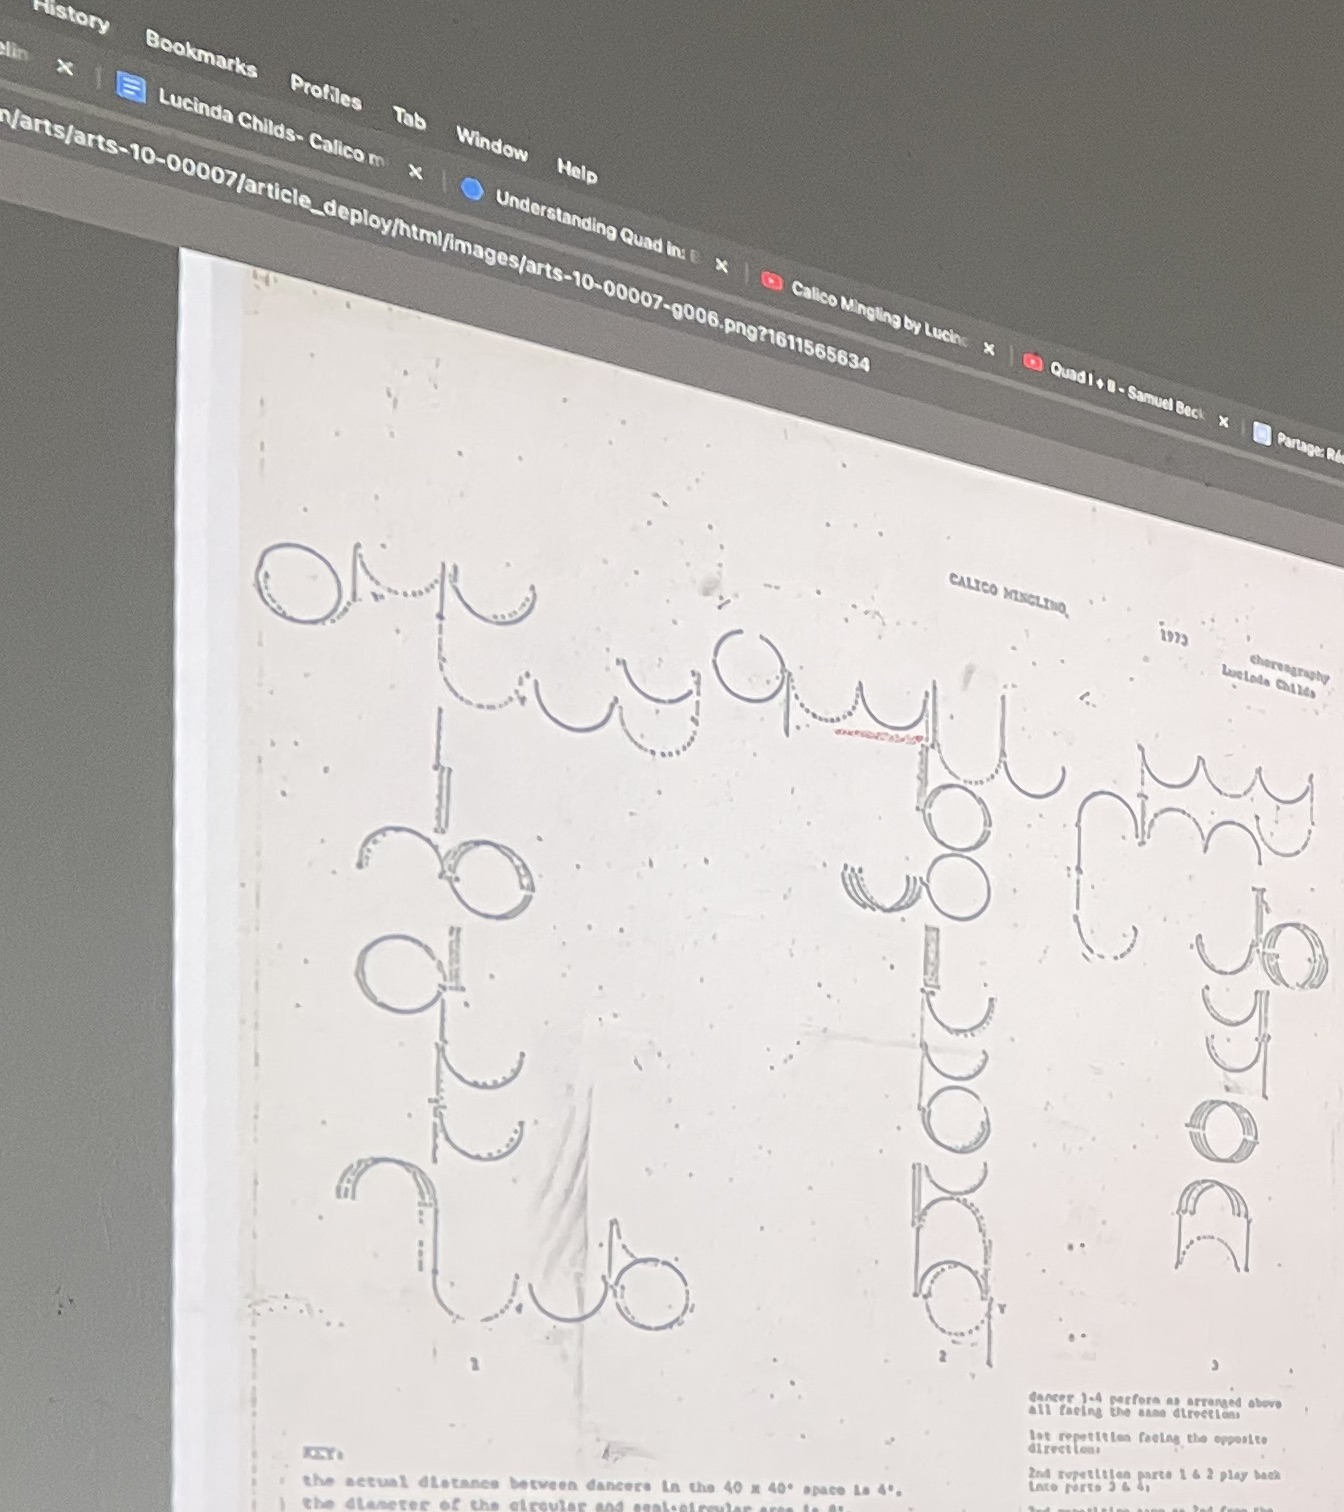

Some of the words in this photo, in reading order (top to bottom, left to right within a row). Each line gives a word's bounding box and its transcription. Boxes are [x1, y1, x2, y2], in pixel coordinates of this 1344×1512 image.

[33, 0, 110, 35] History
[145, 28, 258, 78] Bookmarks
[290, 73, 362, 111] Profiles
[393, 105, 427, 131] Tab
[456, 125, 528, 163] Window
[557, 157, 598, 185] Help
[159, 87, 234, 124] Lucinda
[309, 132, 365, 163] Calico
[496, 189, 617, 242] Understanding
[620, 226, 664, 255] Quad
[791, 280, 838, 308] Calico
[841, 295, 902, 330] Mingling
[904, 314, 921, 336] by
[1050, 361, 1086, 385] Quad
[1128, 386, 1173, 412] Samuel
[949, 573, 998, 597] CALICO
[1160, 628, 1189, 646] 1973
[1221, 663, 1270, 687] Lucinda
[1275, 678, 1316, 699] Childs
[1250, 654, 1330, 685] choreography
[1028, 1391, 1075, 1404] dancer
[1109, 1393, 1161, 1407] perform
[1165, 1396, 1180, 1407] as
[1187, 1396, 1243, 1410] arranged
[1248, 1397, 1283, 1410] above
[1028, 1403, 1052, 1416] all
[1059, 1403, 1103, 1419] facing
[1109, 1406, 1131, 1418] the
[1138, 1408, 1167, 1418] same
[1029, 1429, 1051, 1441] 1st
[1058, 1431, 1131, 1444] repetition
[1138, 1431, 1180, 1445] facing
[1187, 1433, 1208, 1444] the
[1214, 1434, 1268, 1447] opposite
[303, 1473, 335, 1487] the
[345, 1474, 409, 1489] actual
[418, 1475, 500, 1490] distance
[509, 1476, 578, 1490] between
[586, 1478, 652, 1493] dancers
[662, 1479, 681, 1493] in
[690, 1480, 716, 1494] the
[724, 1480, 743, 1494] 40
[802, 1482, 846, 1497] space
[853, 1484, 871, 1497] is
[1028, 1467, 1051, 1480] 2nd
[1058, 1468, 1132, 1482] repetition
[1137, 1469, 1173, 1482] parts
[1220, 1469, 1248, 1482] play
[1254, 1469, 1282, 1481] back
[1028, 1480, 1058, 1493] into
[1065, 1482, 1102, 1495] parts
[302, 1496, 335, 1510] the
[345, 1497, 431, 1512] diameter
[439, 1497, 461, 1512] of
[470, 1498, 500, 1512] the
[595, 1500, 624, 1512] and
